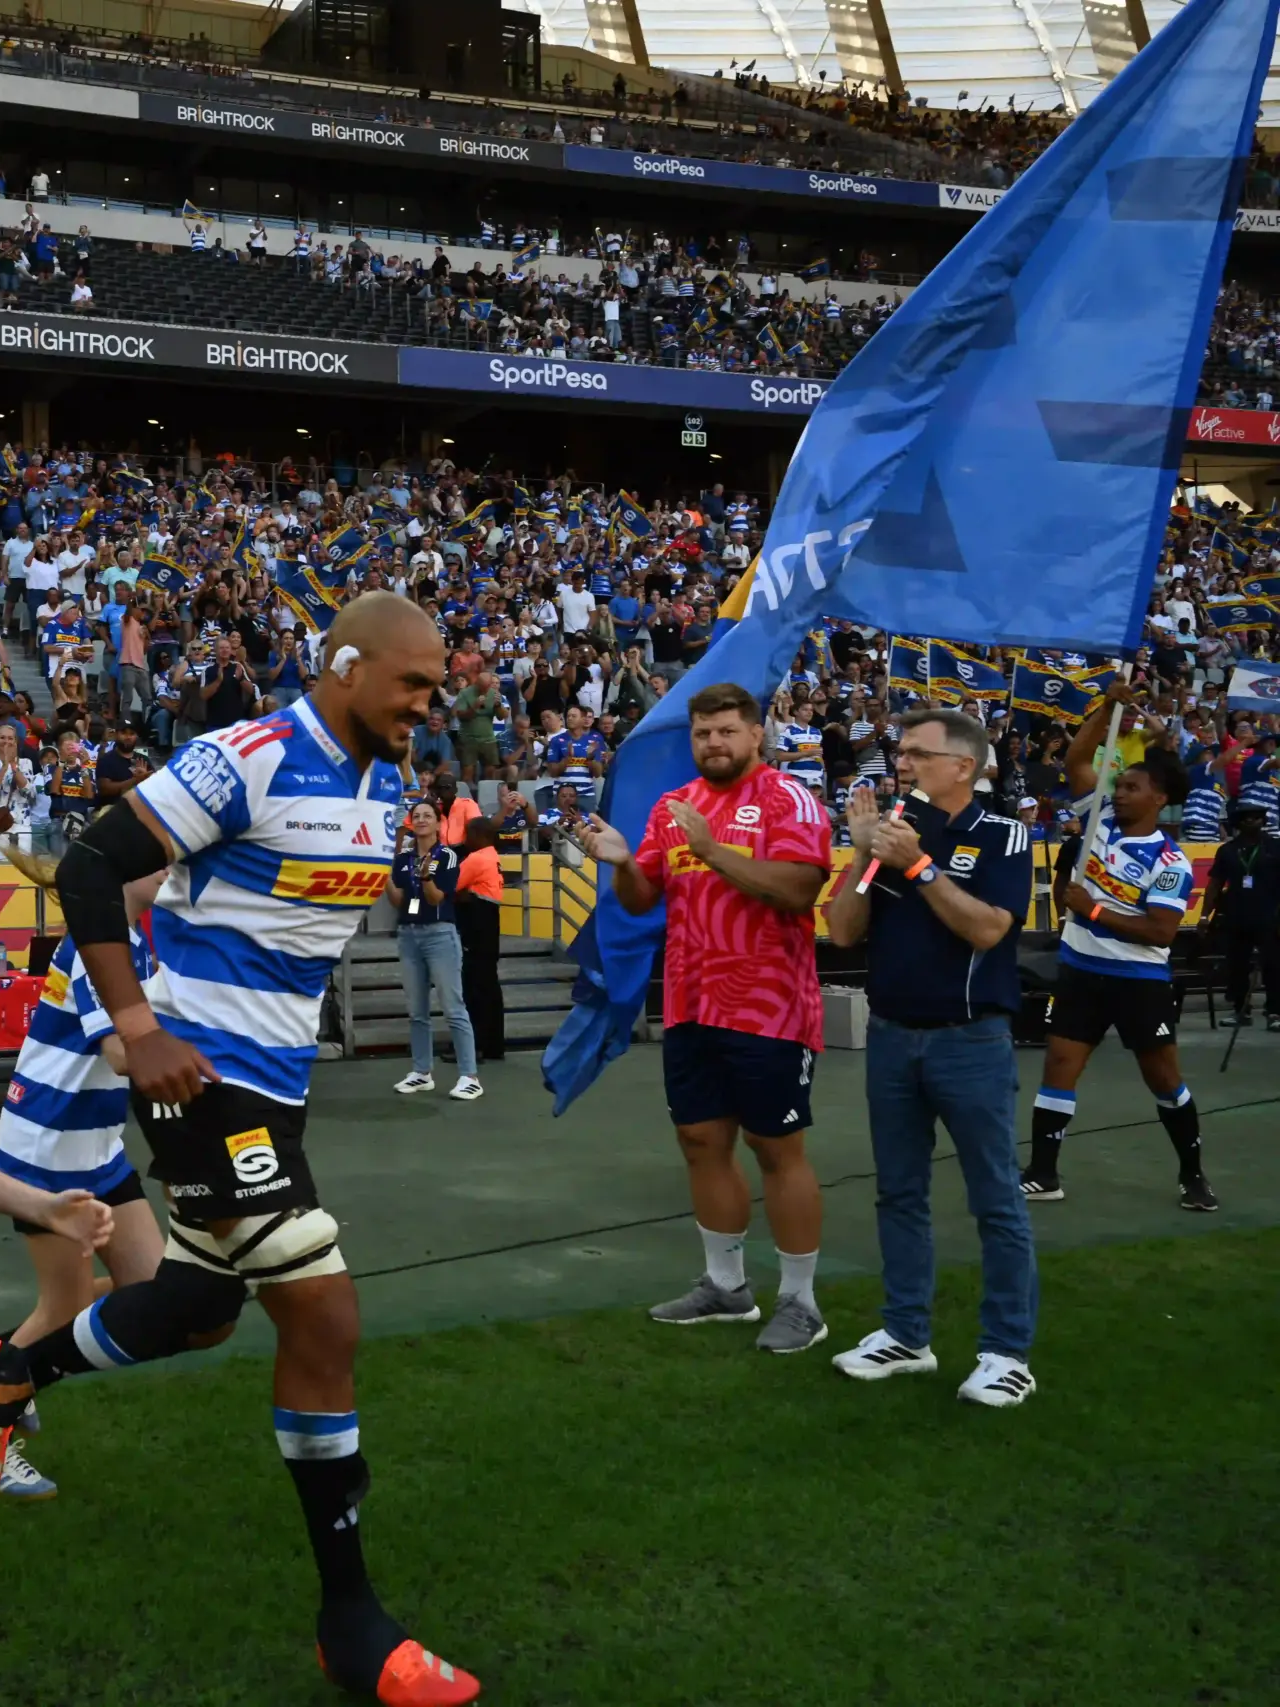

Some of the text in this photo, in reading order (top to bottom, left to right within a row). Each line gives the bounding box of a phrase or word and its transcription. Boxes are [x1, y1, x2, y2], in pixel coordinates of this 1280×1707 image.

[633, 156, 705, 178] SportPesa
[809, 174, 877, 195] SportPesa
[489, 358, 607, 390] SportPesa
[687, 417, 701, 425] 102
[1214, 428, 1245, 439] active
[307, 775, 330, 784] VALR
[235, 1176, 292, 1199] STORMERS
